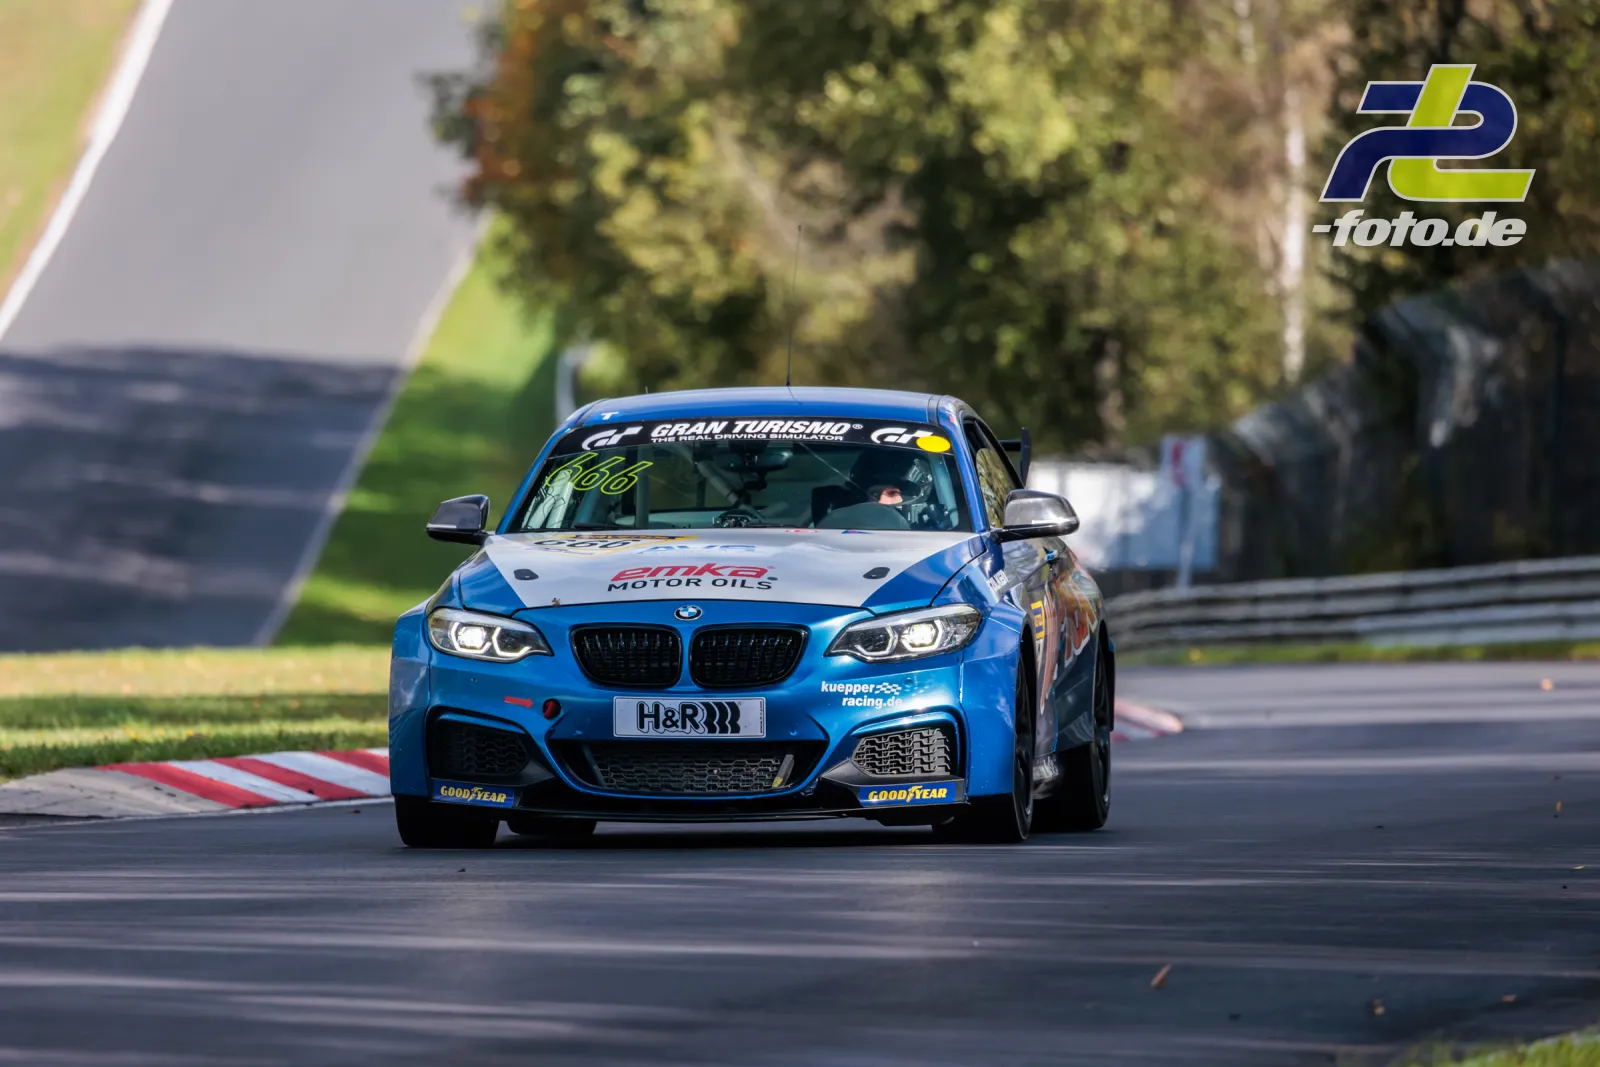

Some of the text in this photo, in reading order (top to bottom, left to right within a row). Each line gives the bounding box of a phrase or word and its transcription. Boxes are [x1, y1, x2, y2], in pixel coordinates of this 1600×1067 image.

[651, 422, 721, 437] GRAN
[715, 433, 766, 441] DRIVING
[769, 433, 844, 441] SIMULATOR
[545, 451, 654, 495] 666
[610, 562, 769, 582] emka
[607, 578, 773, 592] MOTOR OILS
[821, 681, 876, 696] kuepper
[841, 695, 903, 709] racing.de
[637, 701, 706, 734] H&R
[440, 786, 507, 803] GOODYEAR
[868, 785, 948, 802] GOODYEAR
